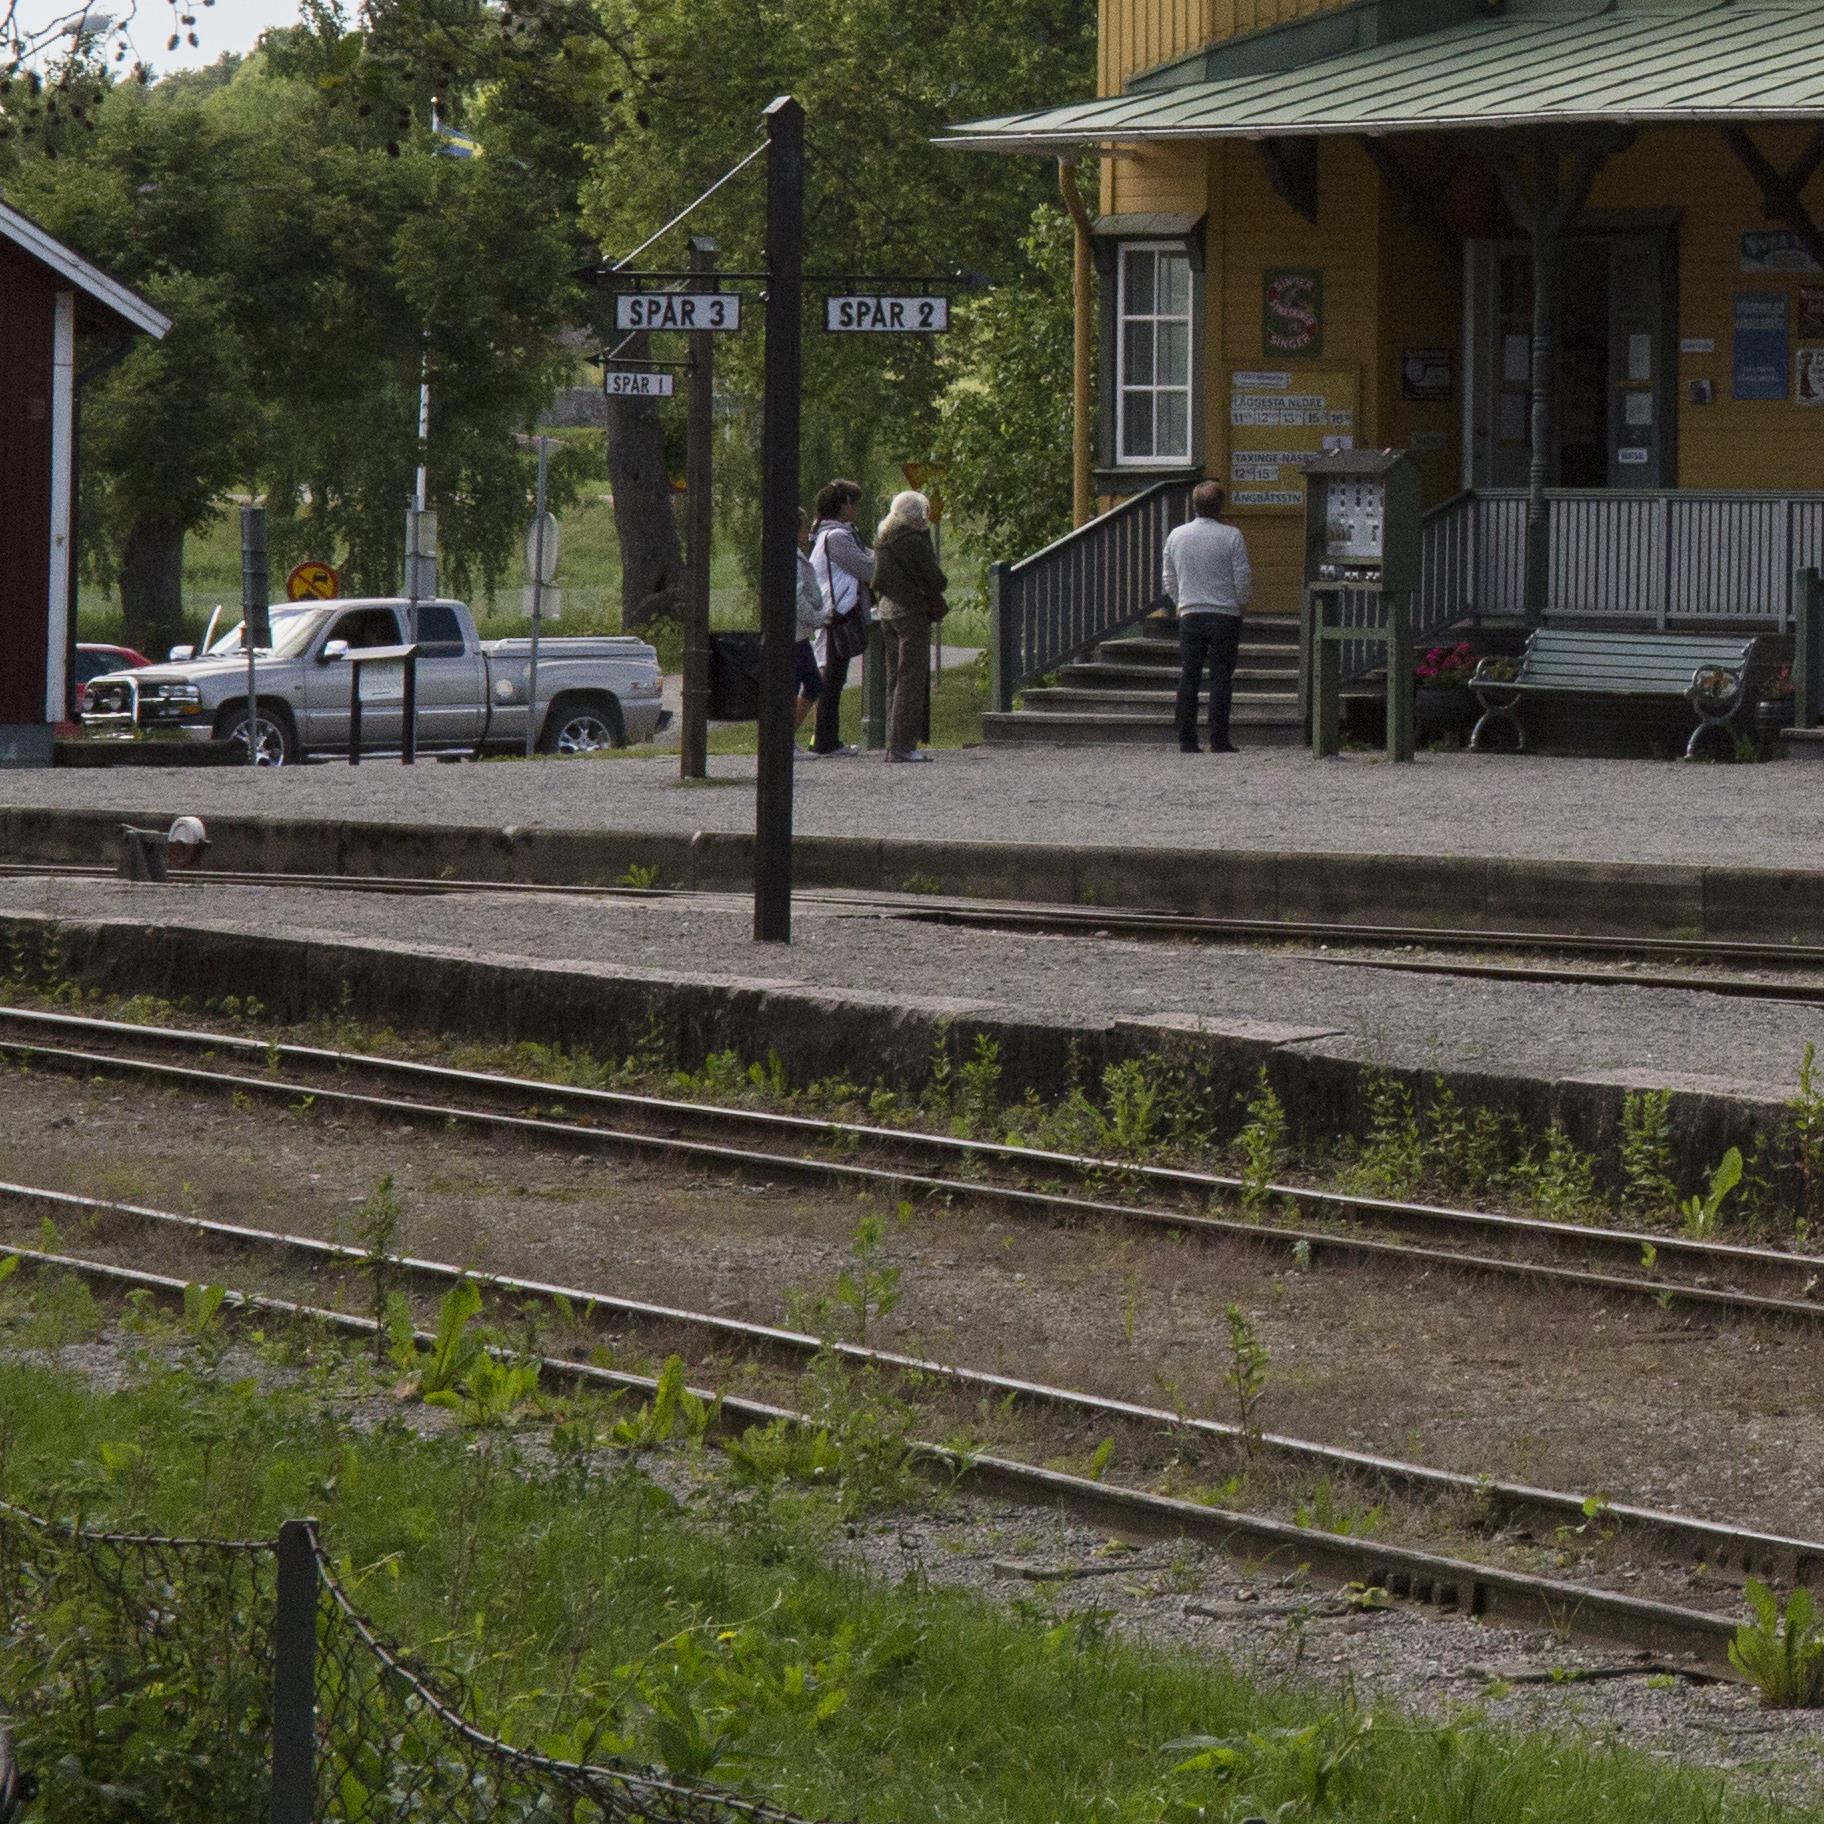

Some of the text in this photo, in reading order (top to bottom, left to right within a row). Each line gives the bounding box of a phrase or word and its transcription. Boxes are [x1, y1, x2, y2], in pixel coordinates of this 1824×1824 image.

[709, 300, 725, 327] 3
[919, 301, 934, 328] 2
[1269, 333, 1312, 350] SINGER
